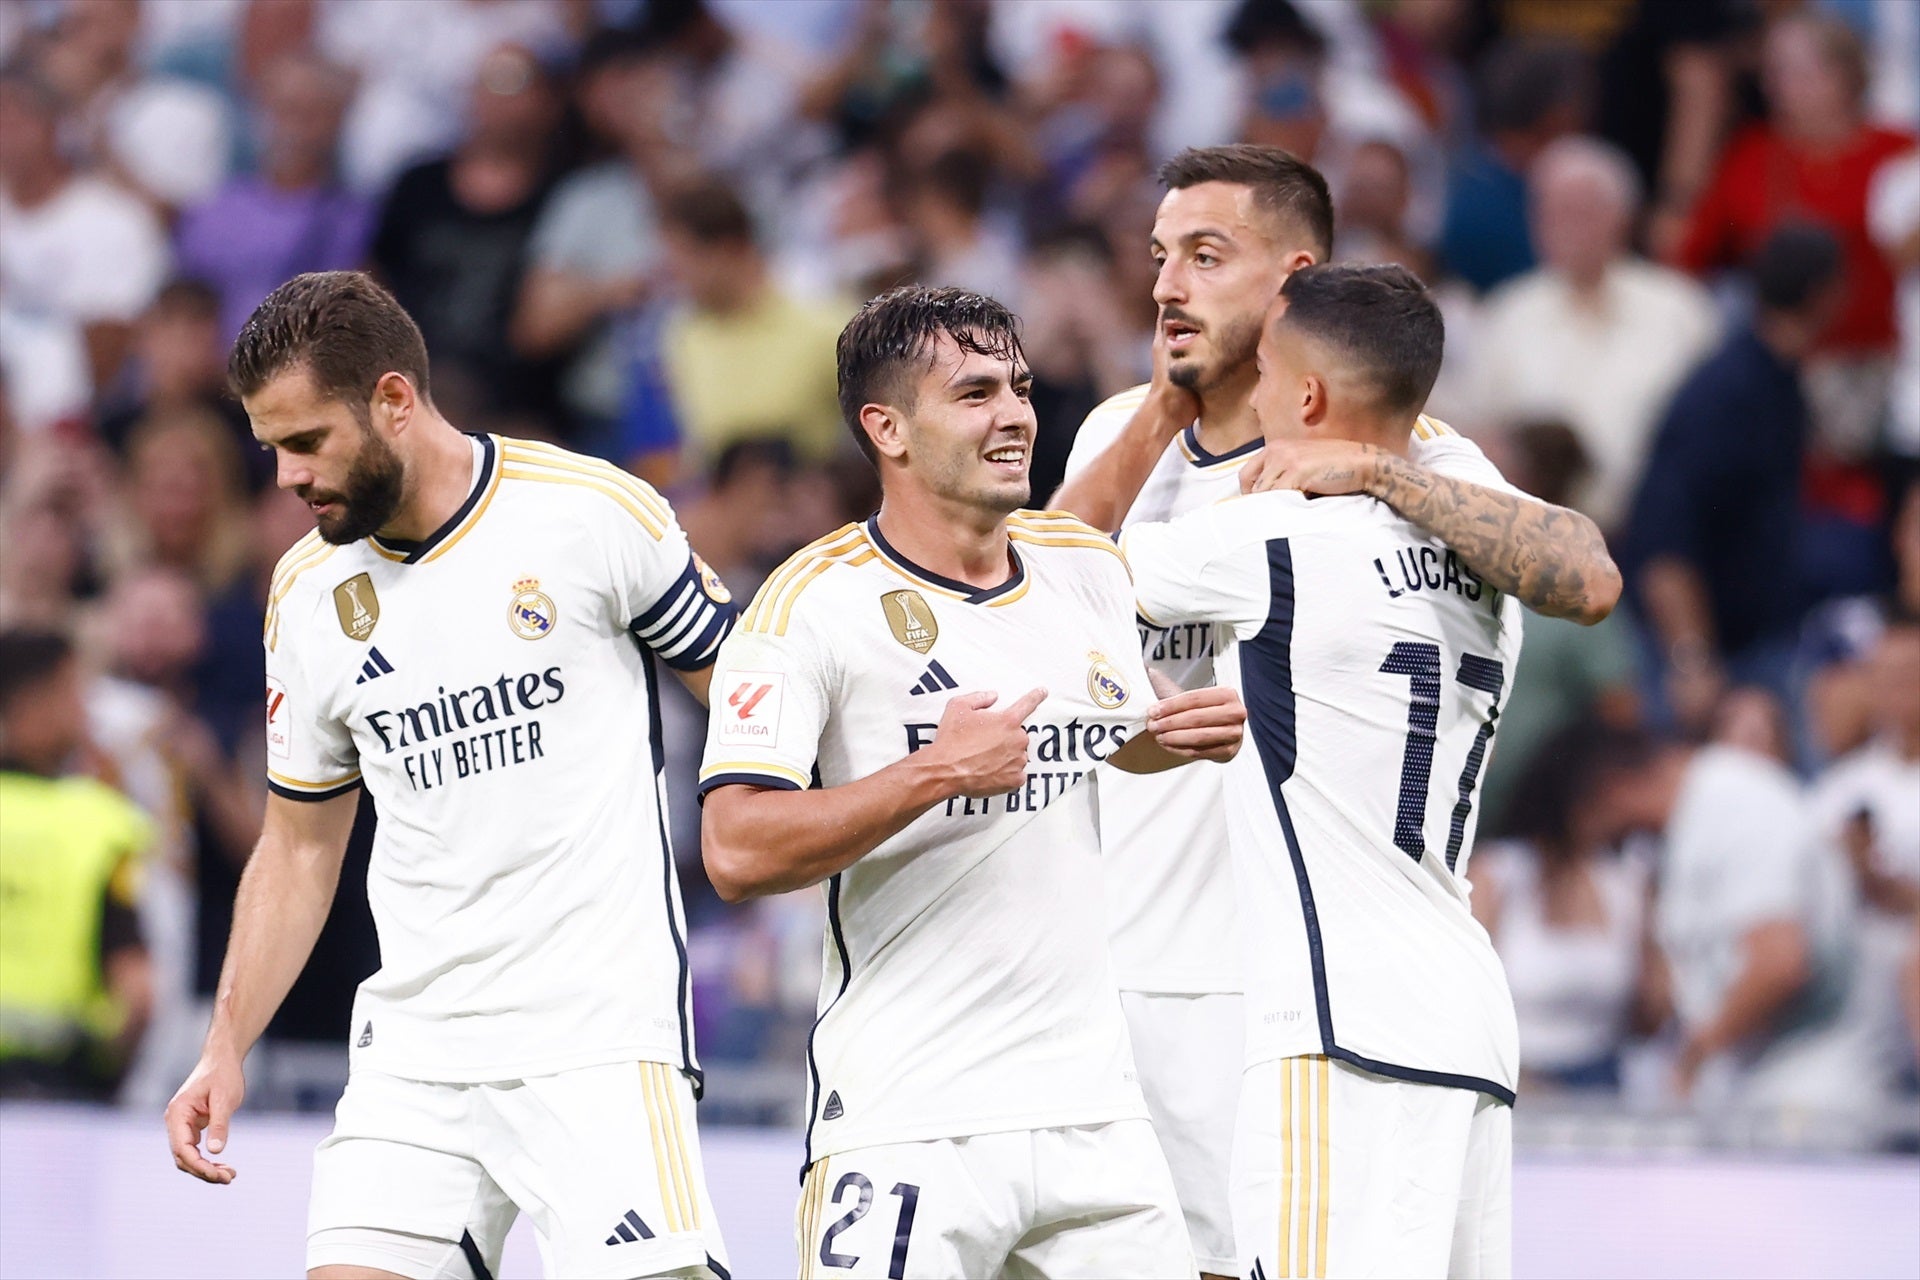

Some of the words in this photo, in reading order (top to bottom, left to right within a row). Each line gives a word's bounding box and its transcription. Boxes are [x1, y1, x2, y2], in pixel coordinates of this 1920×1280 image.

[1373, 546, 1482, 602] LUCAS
[352, 613, 372, 630] FIFA
[905, 629, 928, 641] FIFA
[1152, 622, 1214, 660] BETT
[364, 666, 565, 754] Emirates
[724, 723, 769, 736] LALIGA
[404, 748, 443, 791] FLY
[452, 720, 544, 779] BETTER
[903, 717, 1127, 763] Eates
[1378, 641, 1504, 875] 17
[1006, 772, 1083, 812] BETT
[819, 1171, 920, 1280] 21
